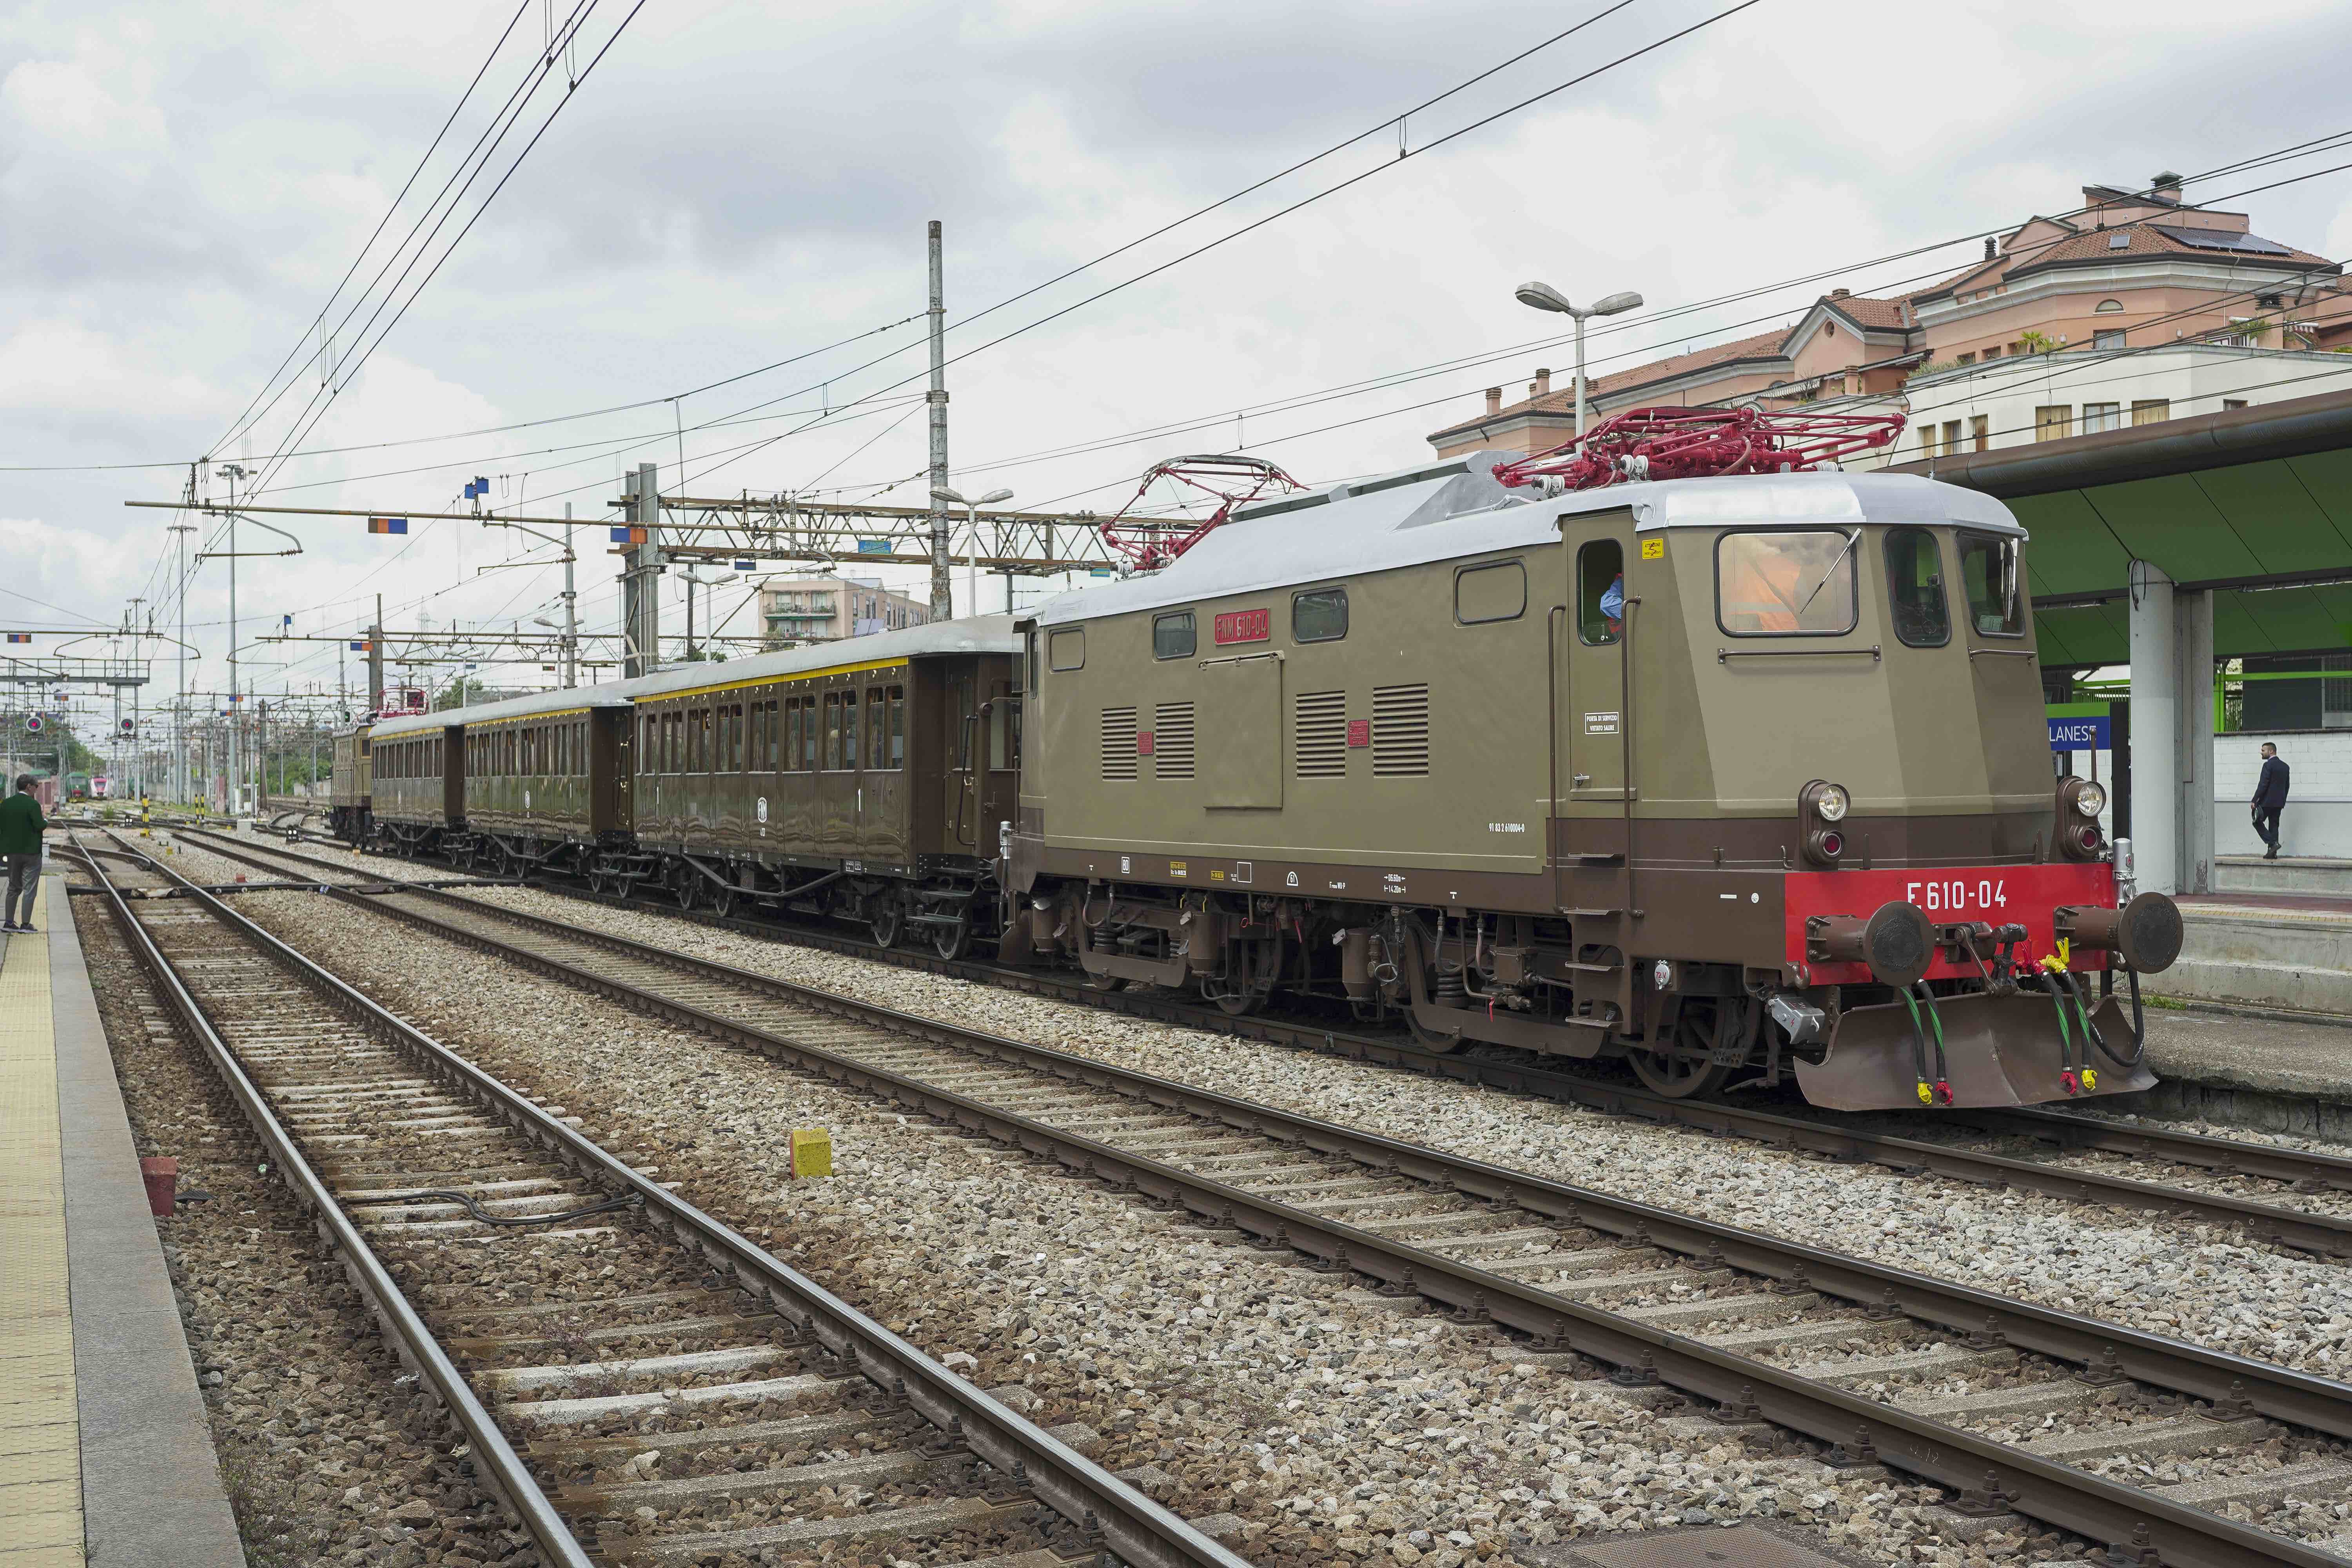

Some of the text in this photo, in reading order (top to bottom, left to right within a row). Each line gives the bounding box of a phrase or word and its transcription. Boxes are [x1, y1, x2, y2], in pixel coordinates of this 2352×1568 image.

[1217, 613, 1267, 640] FNM 610-04
[1489, 823, 1525, 833] 91 83 2 610004-0
